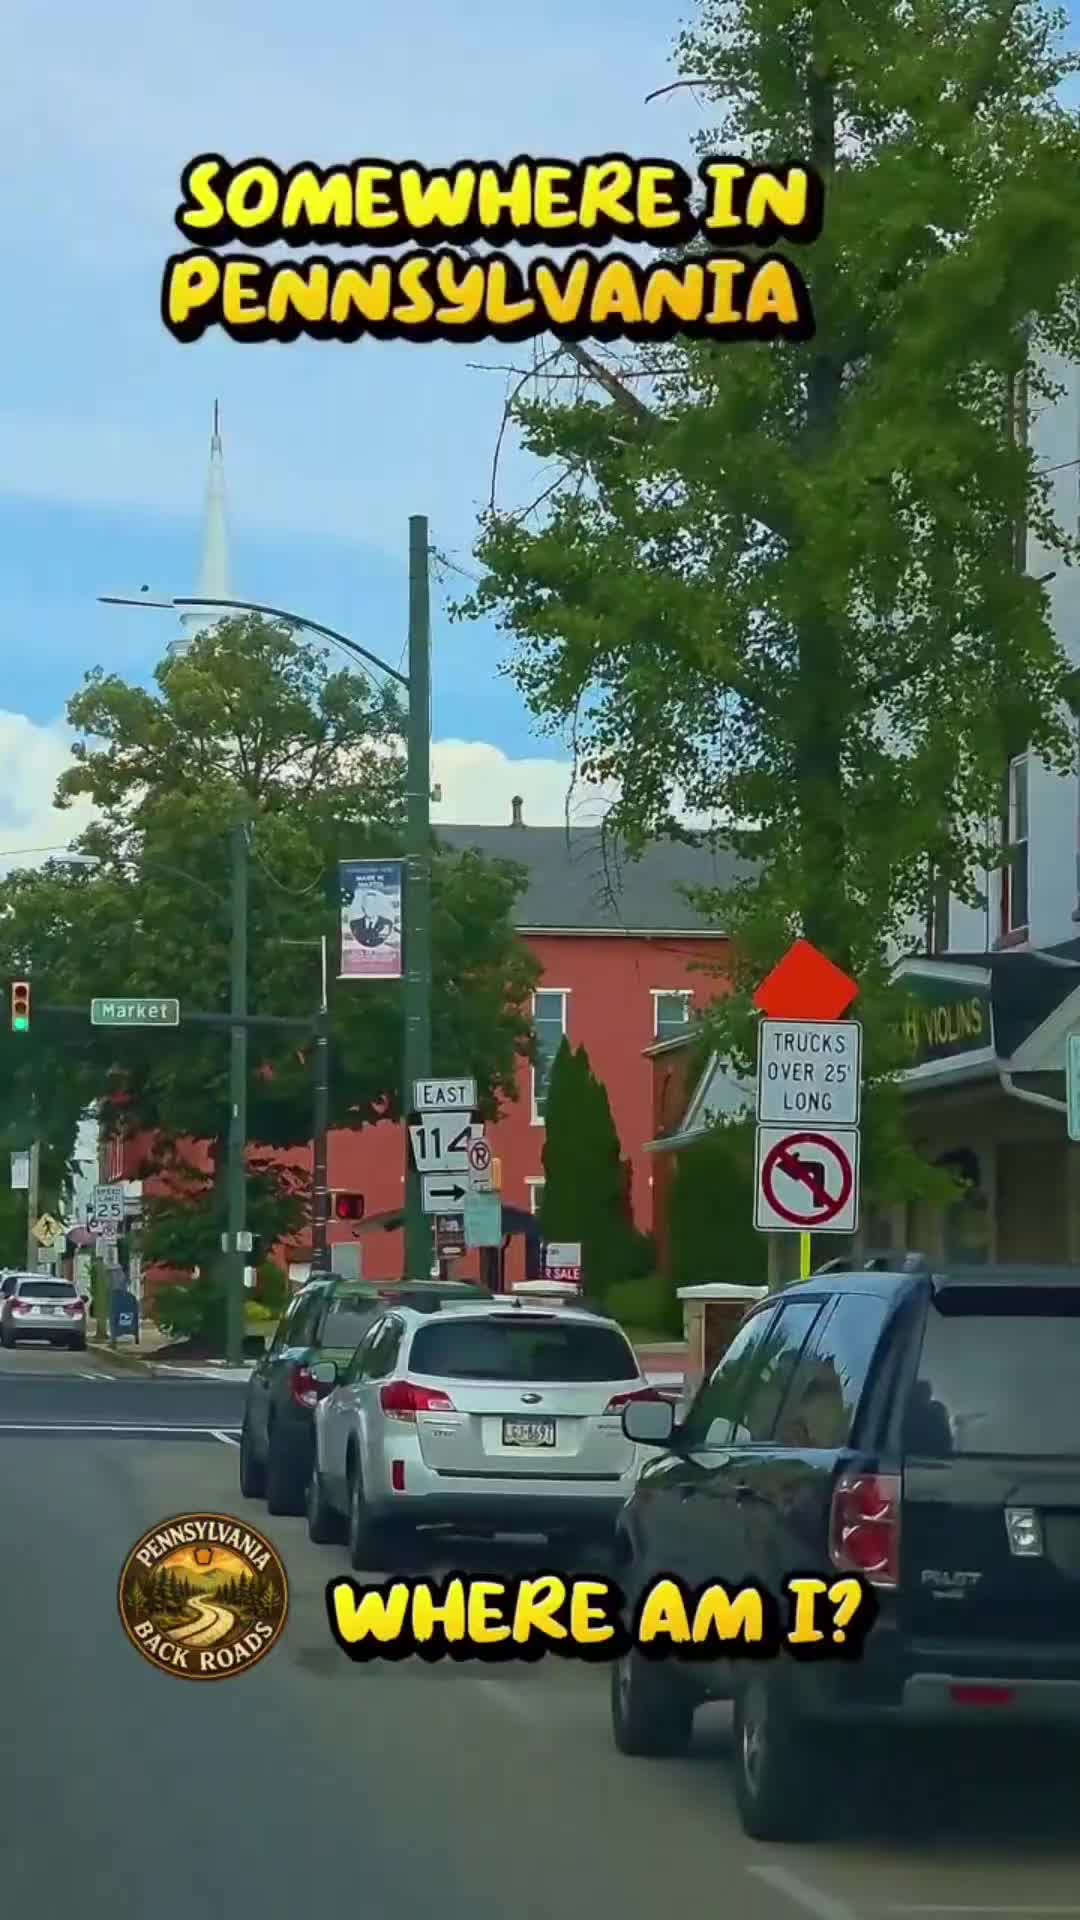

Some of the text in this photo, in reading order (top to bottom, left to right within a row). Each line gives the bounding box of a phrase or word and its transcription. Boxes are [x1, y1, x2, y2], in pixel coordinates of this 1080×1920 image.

[102, 1003, 168, 1019] Market
[922, 997, 982, 1046] VIOLINS
[774, 1032, 845, 1054] TRUCKS
[767, 1062, 851, 1083] OVER 25'
[424, 1085, 466, 1105] EAST
[783, 1091, 832, 1112] LONG
[415, 1125, 473, 1160] 114
[97, 1203, 121, 1217] 25
[553, 1268, 581, 1281] SALE
